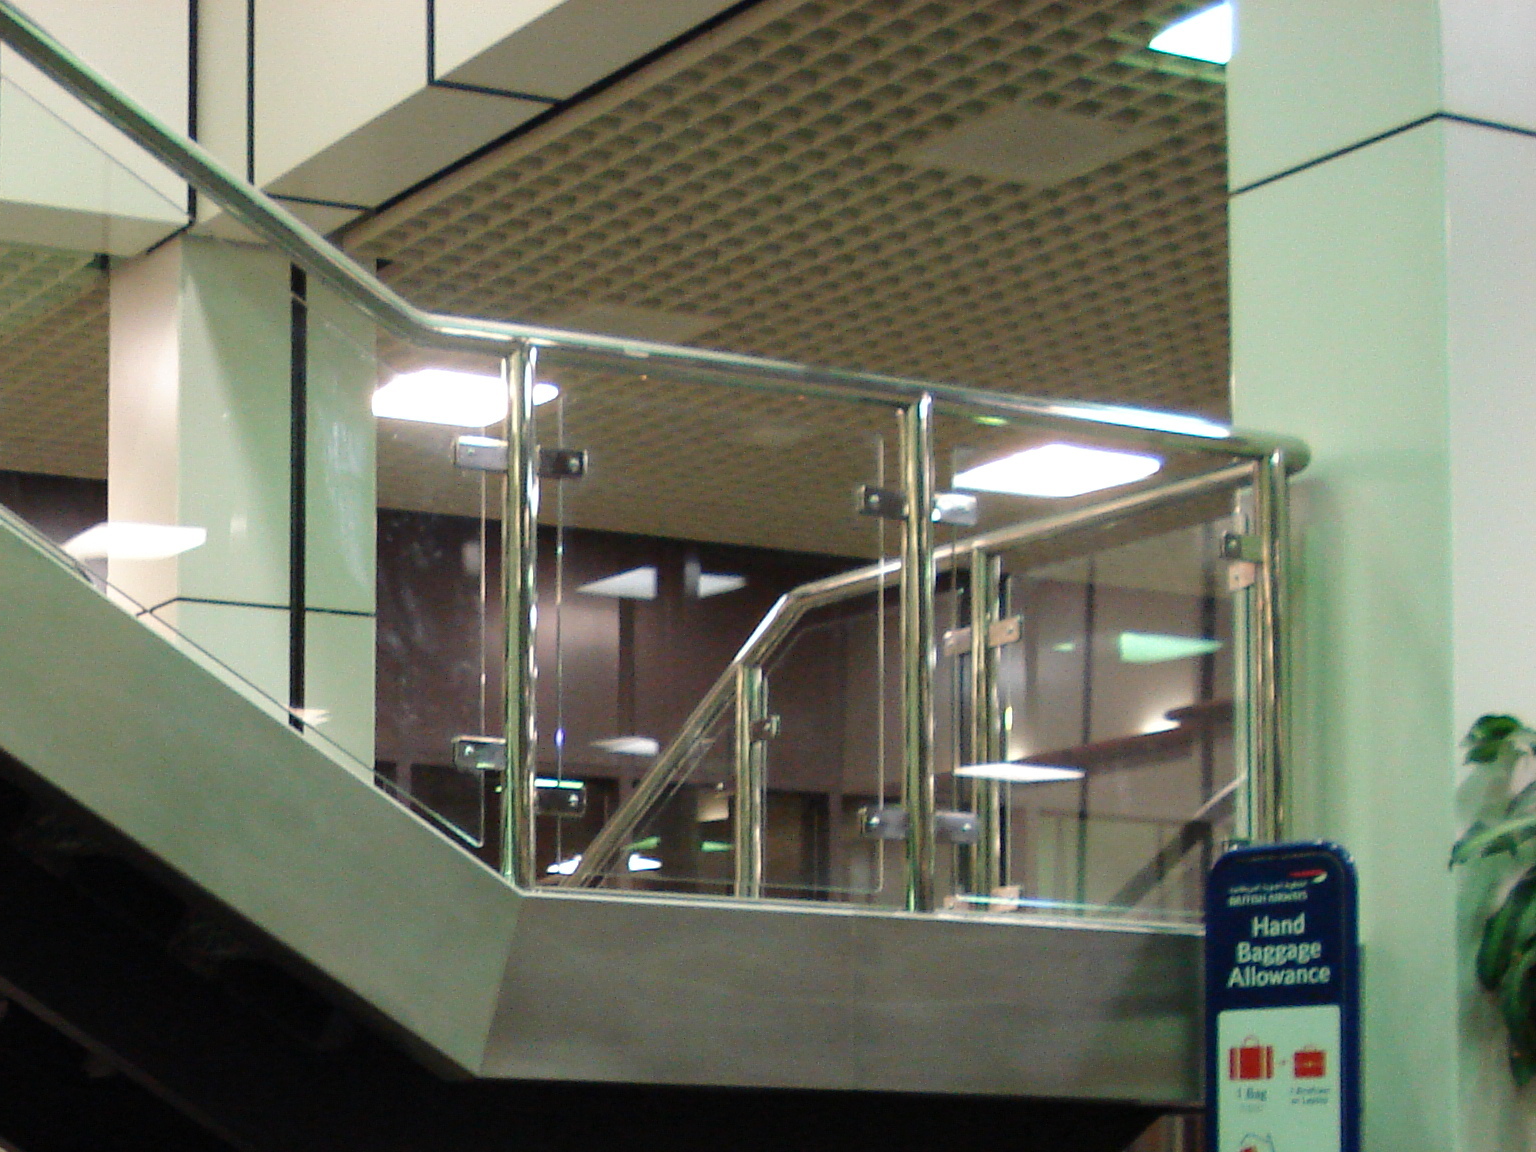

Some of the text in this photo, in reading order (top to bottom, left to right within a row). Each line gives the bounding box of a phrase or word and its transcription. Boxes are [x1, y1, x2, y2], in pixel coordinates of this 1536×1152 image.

[1252, 914, 1305, 938] Hand
[1236, 942, 1322, 966] Baggage
[1227, 966, 1330, 988] Allowance
